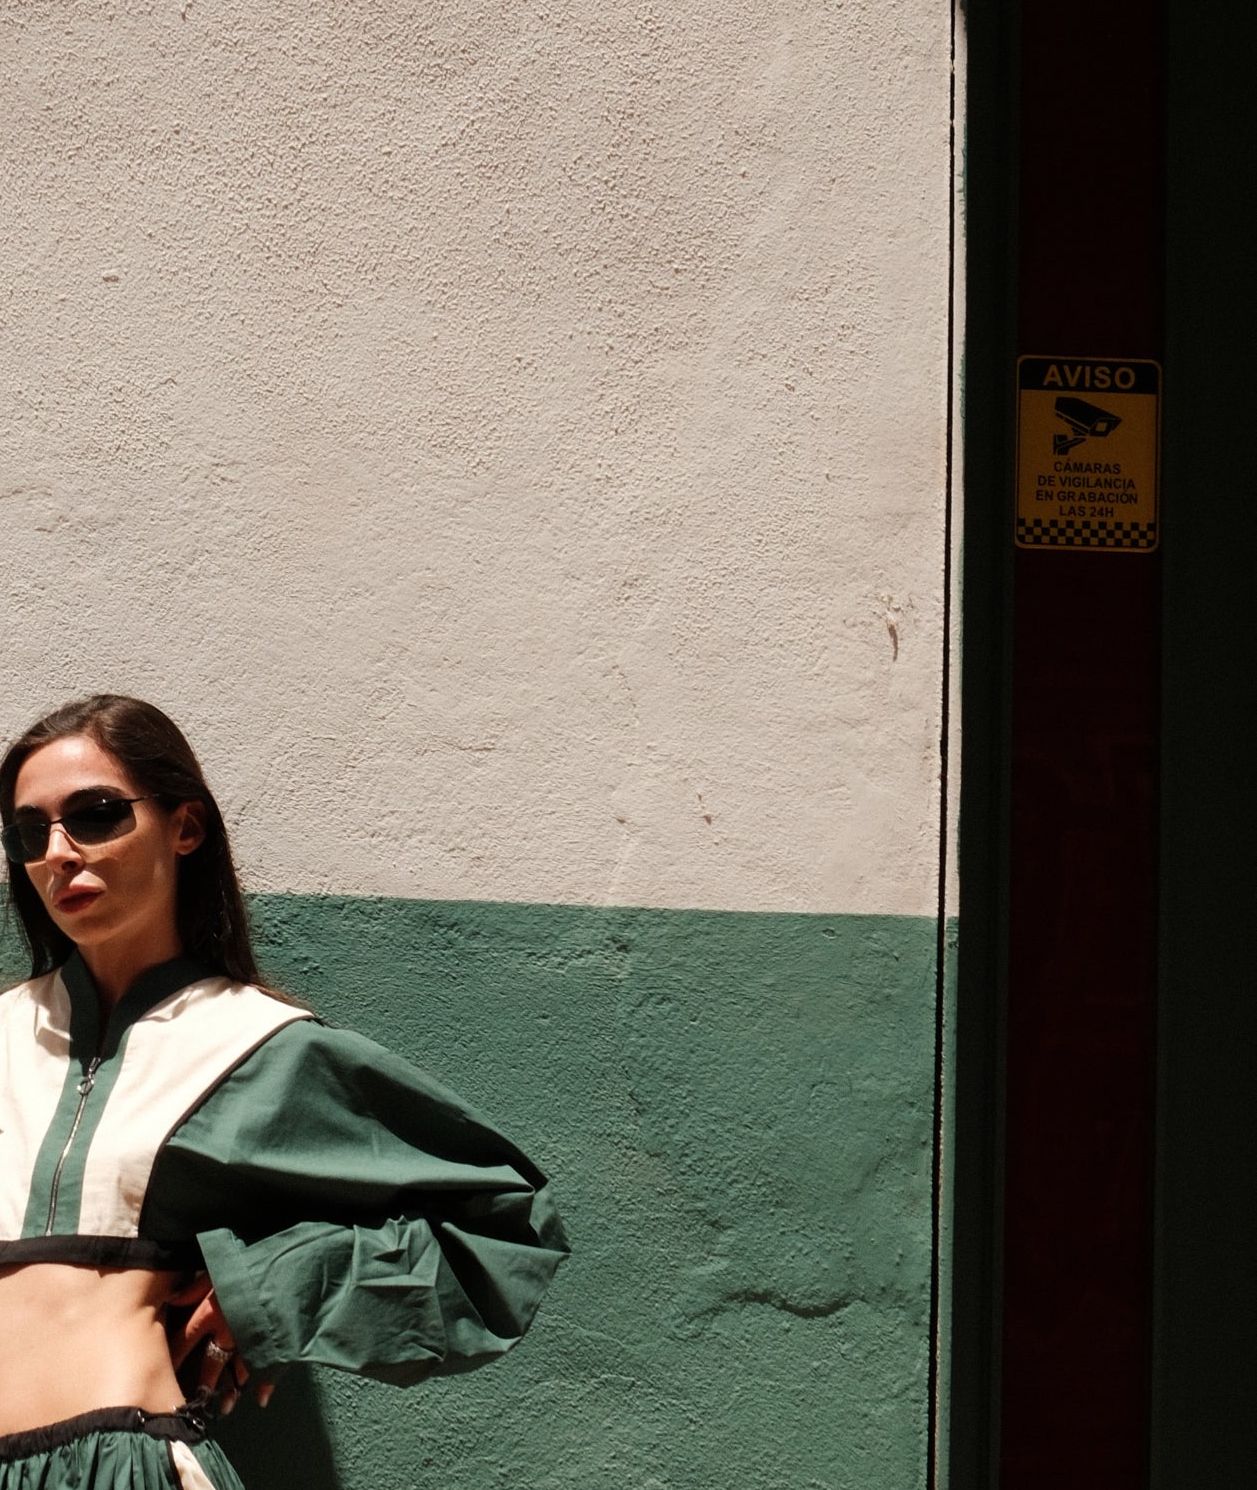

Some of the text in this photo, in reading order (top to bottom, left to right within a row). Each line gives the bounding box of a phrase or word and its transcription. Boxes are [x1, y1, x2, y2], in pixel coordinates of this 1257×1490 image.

[1043, 364, 1136, 390] AVISO
[1054, 458, 1121, 475] CÁMARAS
[1037, 475, 1136, 490] DE VIGILANCIA
[1035, 489, 1138, 504] EN GRABACIÓN
[1059, 505, 1114, 518] LAS 24H
